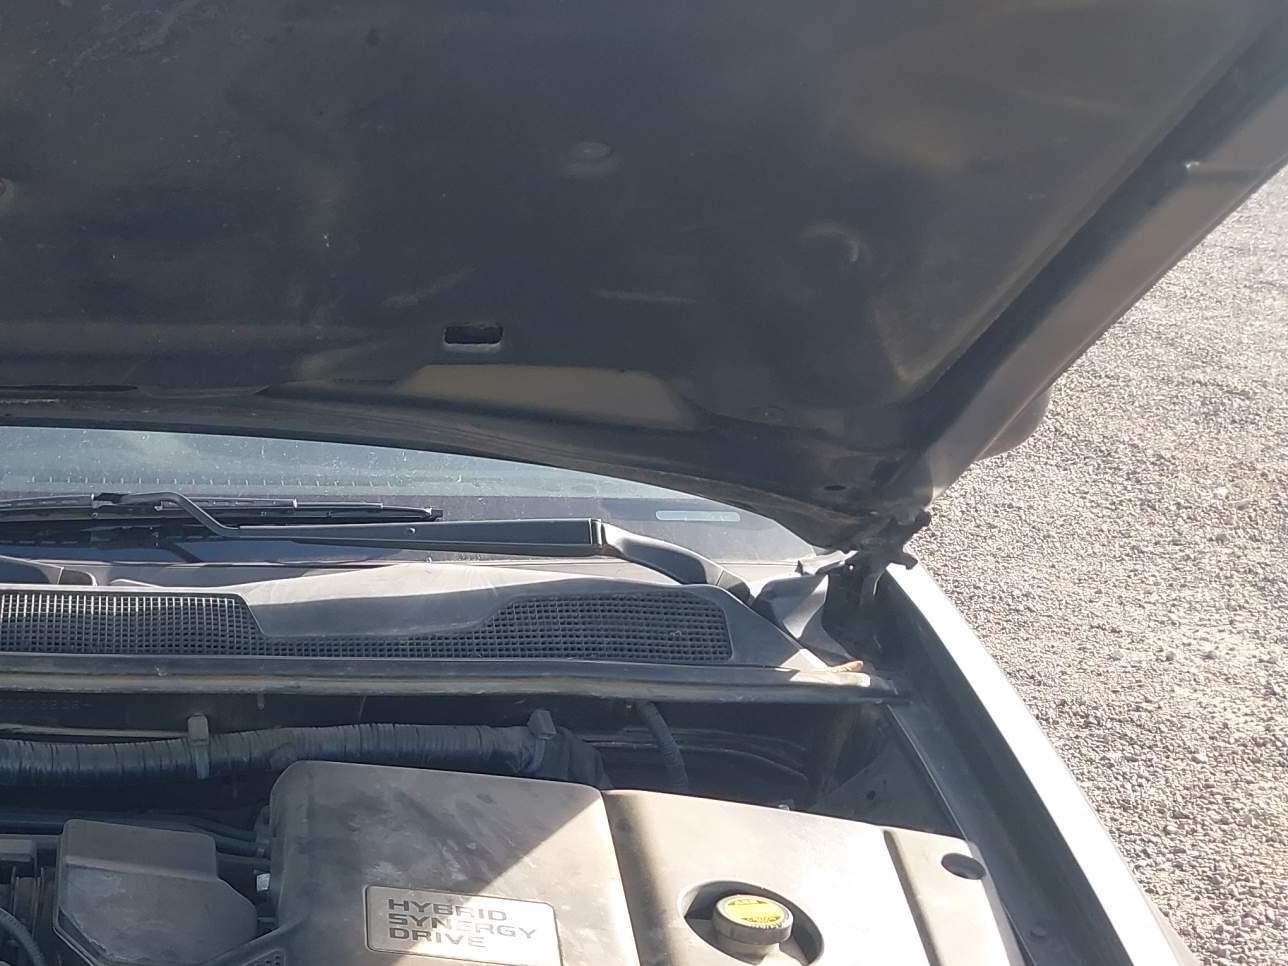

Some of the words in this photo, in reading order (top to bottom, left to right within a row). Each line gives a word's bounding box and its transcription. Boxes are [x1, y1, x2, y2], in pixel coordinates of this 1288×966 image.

[388, 898, 507, 921] HYBRID
[388, 912, 537, 940] SYNERGY
[389, 926, 487, 949] DRIVE
